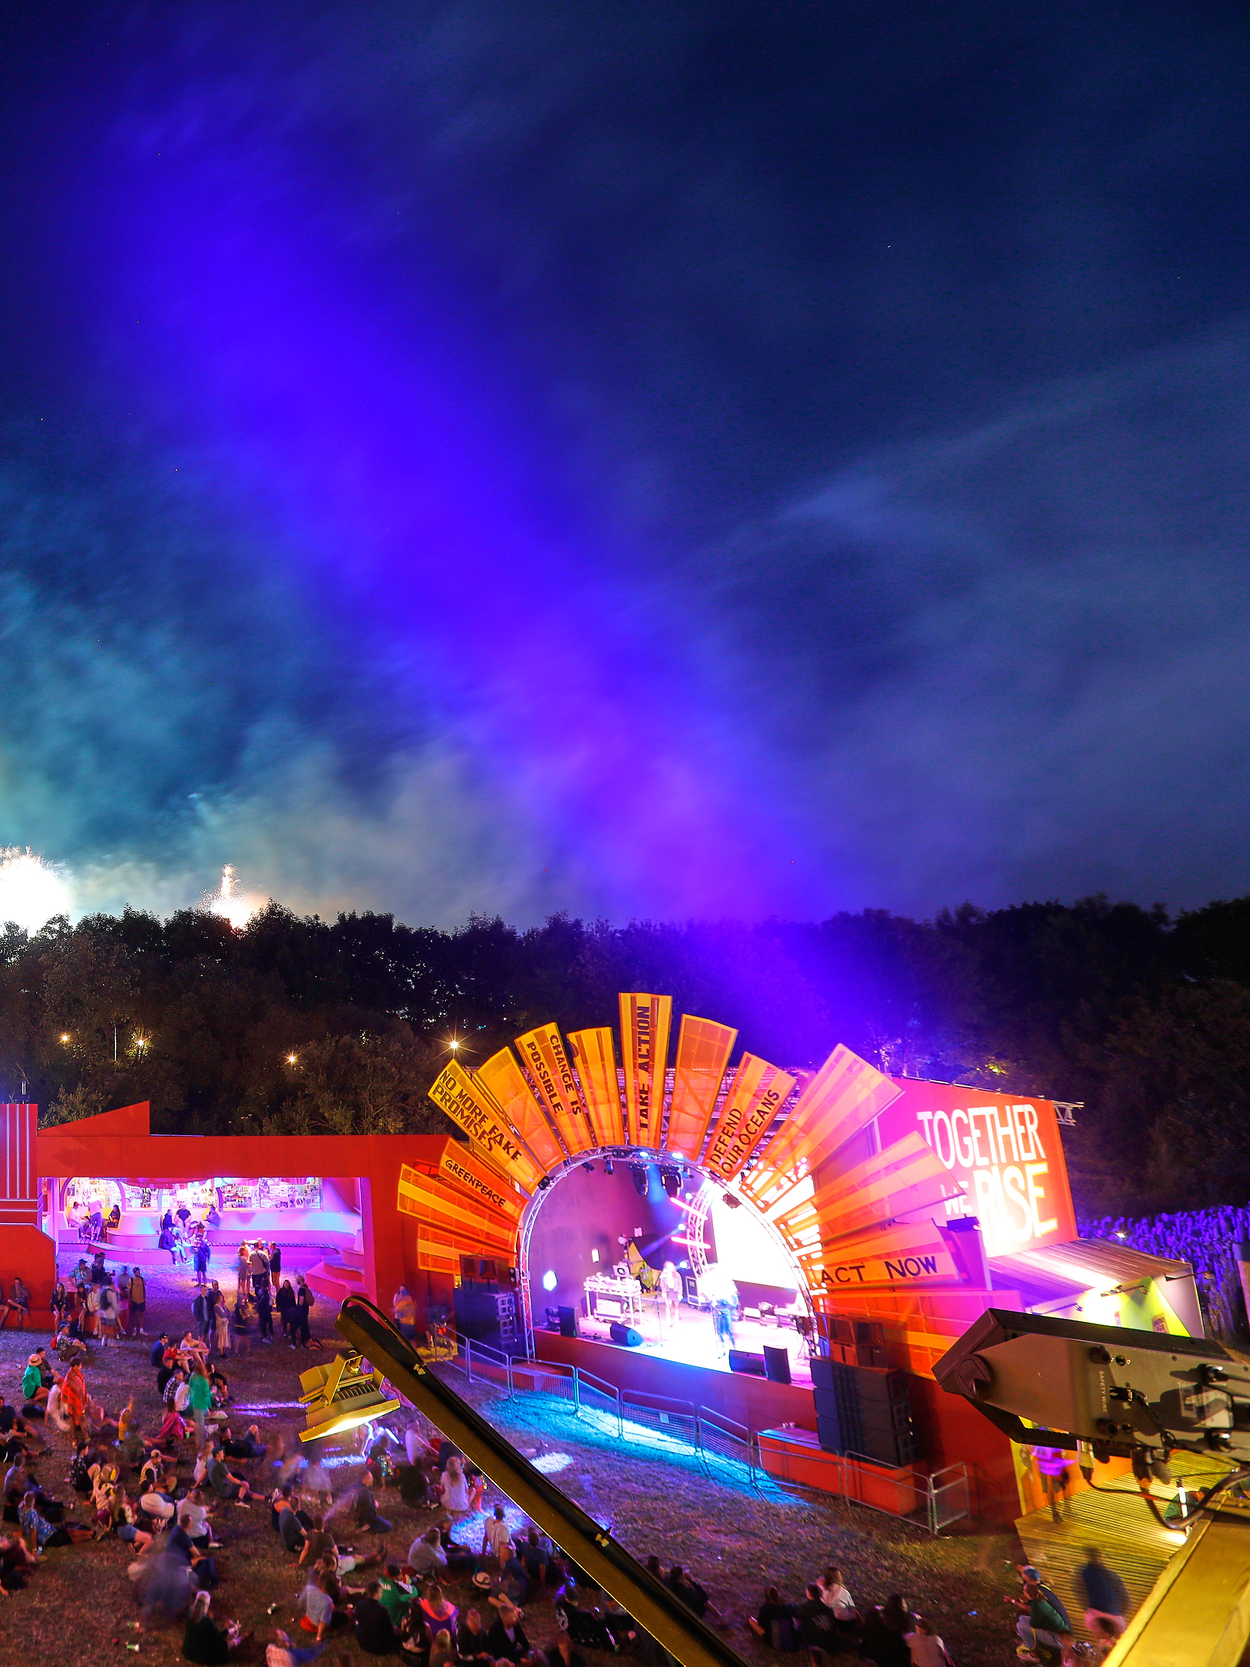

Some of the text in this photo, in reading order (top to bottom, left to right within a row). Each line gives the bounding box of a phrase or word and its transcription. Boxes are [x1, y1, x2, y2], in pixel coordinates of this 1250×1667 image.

[526, 1041, 565, 1115] POSSIBLE
[550, 1034, 582, 1116] CHANGE IS
[636, 1005, 650, 1129] TAKE ACTION
[432, 1082, 497, 1152] PROMISES
[438, 1069, 523, 1162] NO MORE FAKE
[709, 1107, 743, 1165] DEFEND
[721, 1089, 781, 1174] OUR OCEANS
[916, 1103, 1047, 1170] TOGETHER
[445, 1159, 507, 1208] GREENPEACE
[940, 1161, 1058, 1254] WE RISE
[820, 1255, 939, 1284] ACT NOW
